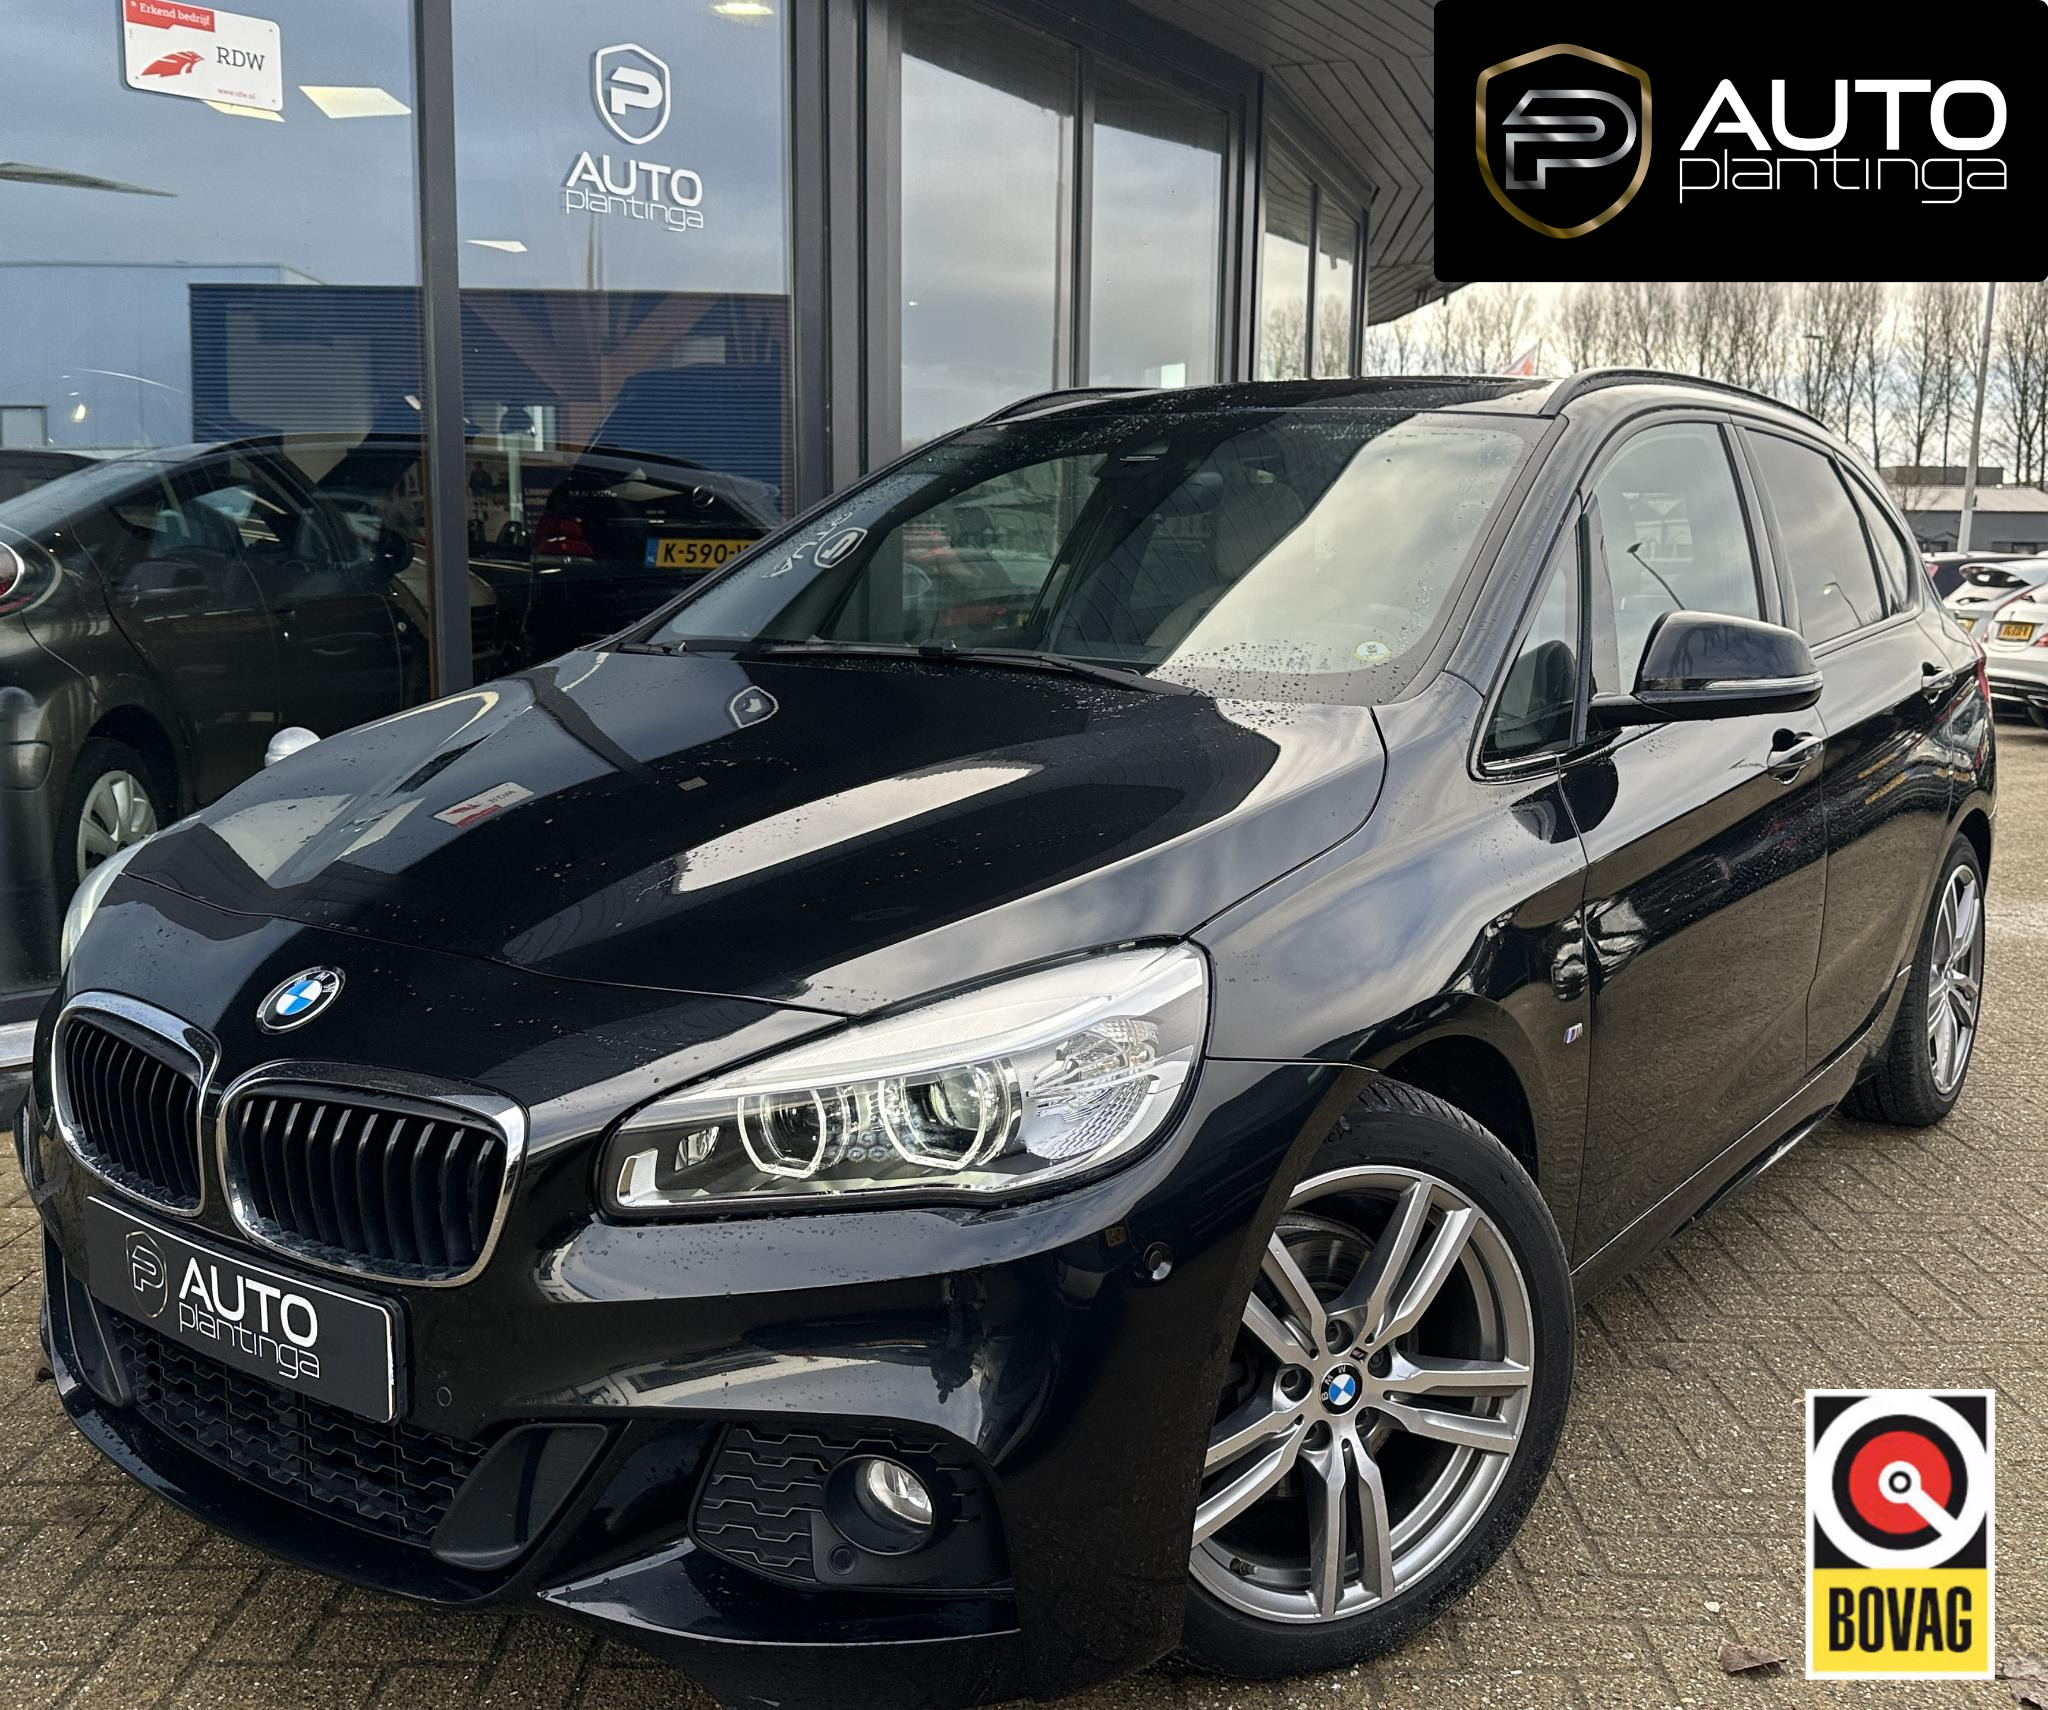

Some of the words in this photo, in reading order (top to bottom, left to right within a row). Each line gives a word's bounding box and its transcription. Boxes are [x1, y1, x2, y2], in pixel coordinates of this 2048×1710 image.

[139, 3, 177, 19] Erkend
[177, 11, 211, 26] bedrijf
[216, 46, 265, 72] RDW
[566, 151, 703, 207] AUTO
[566, 188, 704, 232] plantinga
[178, 1256, 319, 1348] AUTO
[178, 1301, 320, 1380] plantinga
